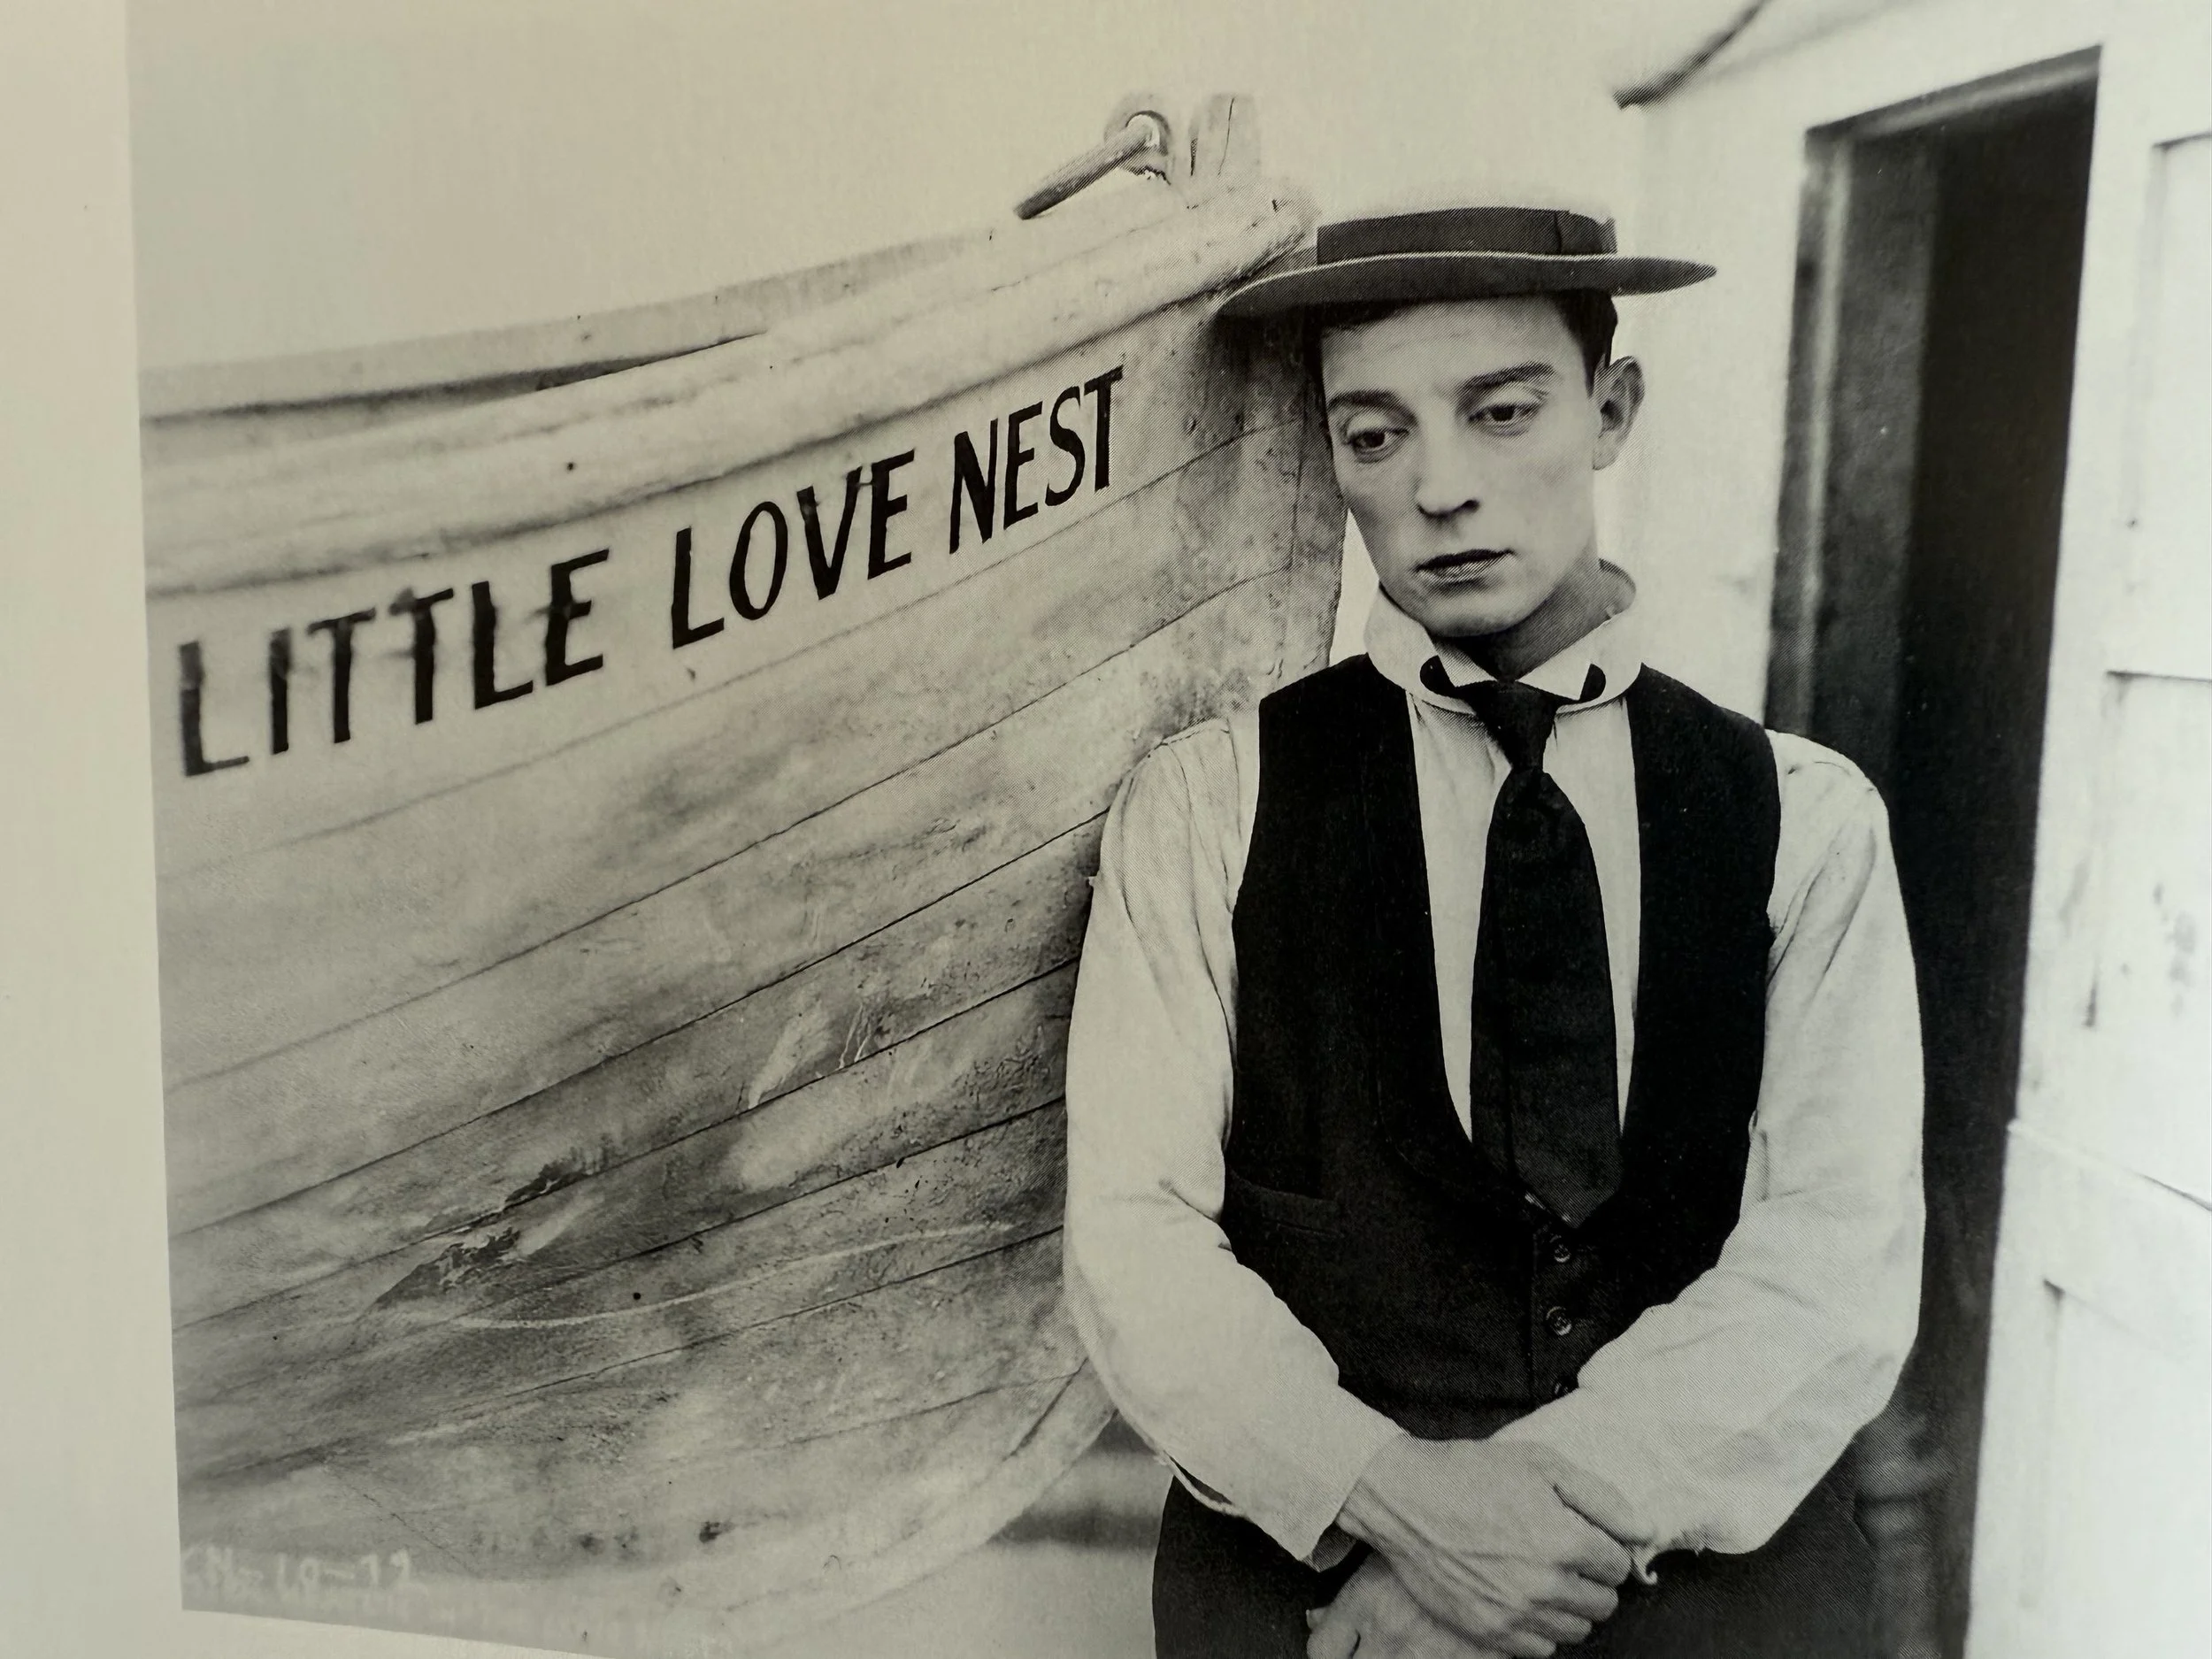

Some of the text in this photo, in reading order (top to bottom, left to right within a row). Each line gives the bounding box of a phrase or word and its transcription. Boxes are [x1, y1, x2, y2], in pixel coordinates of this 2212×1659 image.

[178, 364, 1124, 777] LITTLE LOVE NEST
